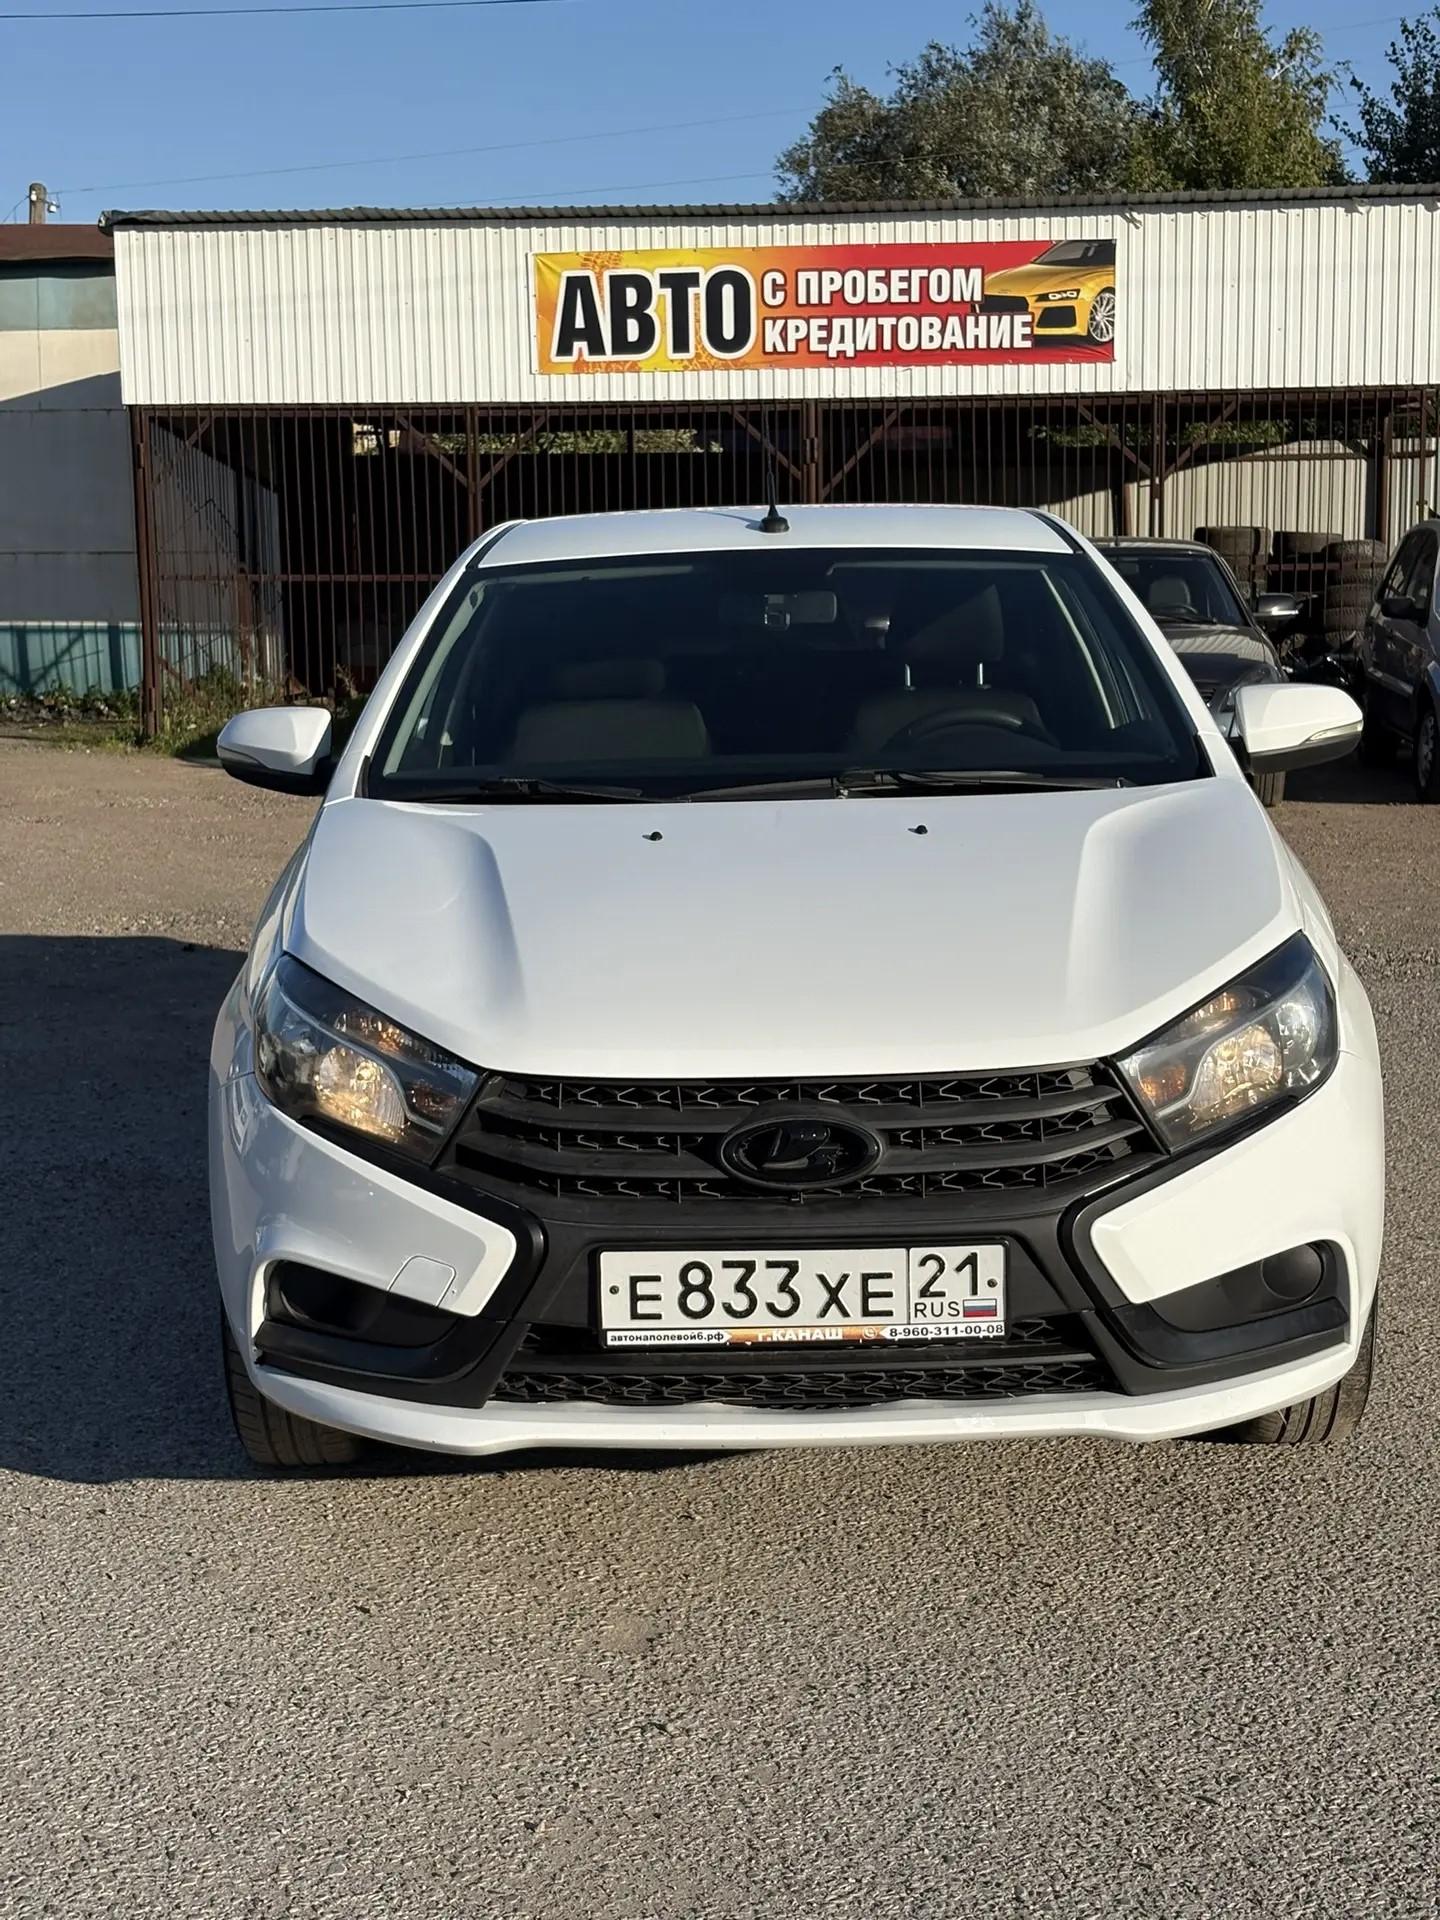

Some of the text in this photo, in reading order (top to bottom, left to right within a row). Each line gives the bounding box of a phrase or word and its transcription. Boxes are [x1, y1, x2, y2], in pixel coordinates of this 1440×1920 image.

[763, 268, 983, 305] С ПРОБЕГОМ
[553, 267, 752, 359] АВТО
[763, 315, 1033, 357] КРЕДИТОВАНИЕ
[917, 1251, 979, 1299] 21
[913, 1300, 961, 1319] RUS
[610, 1332, 725, 1343] автонаполевой6.рф
[889, 1324, 1004, 1338] 8-960-311-00-08
